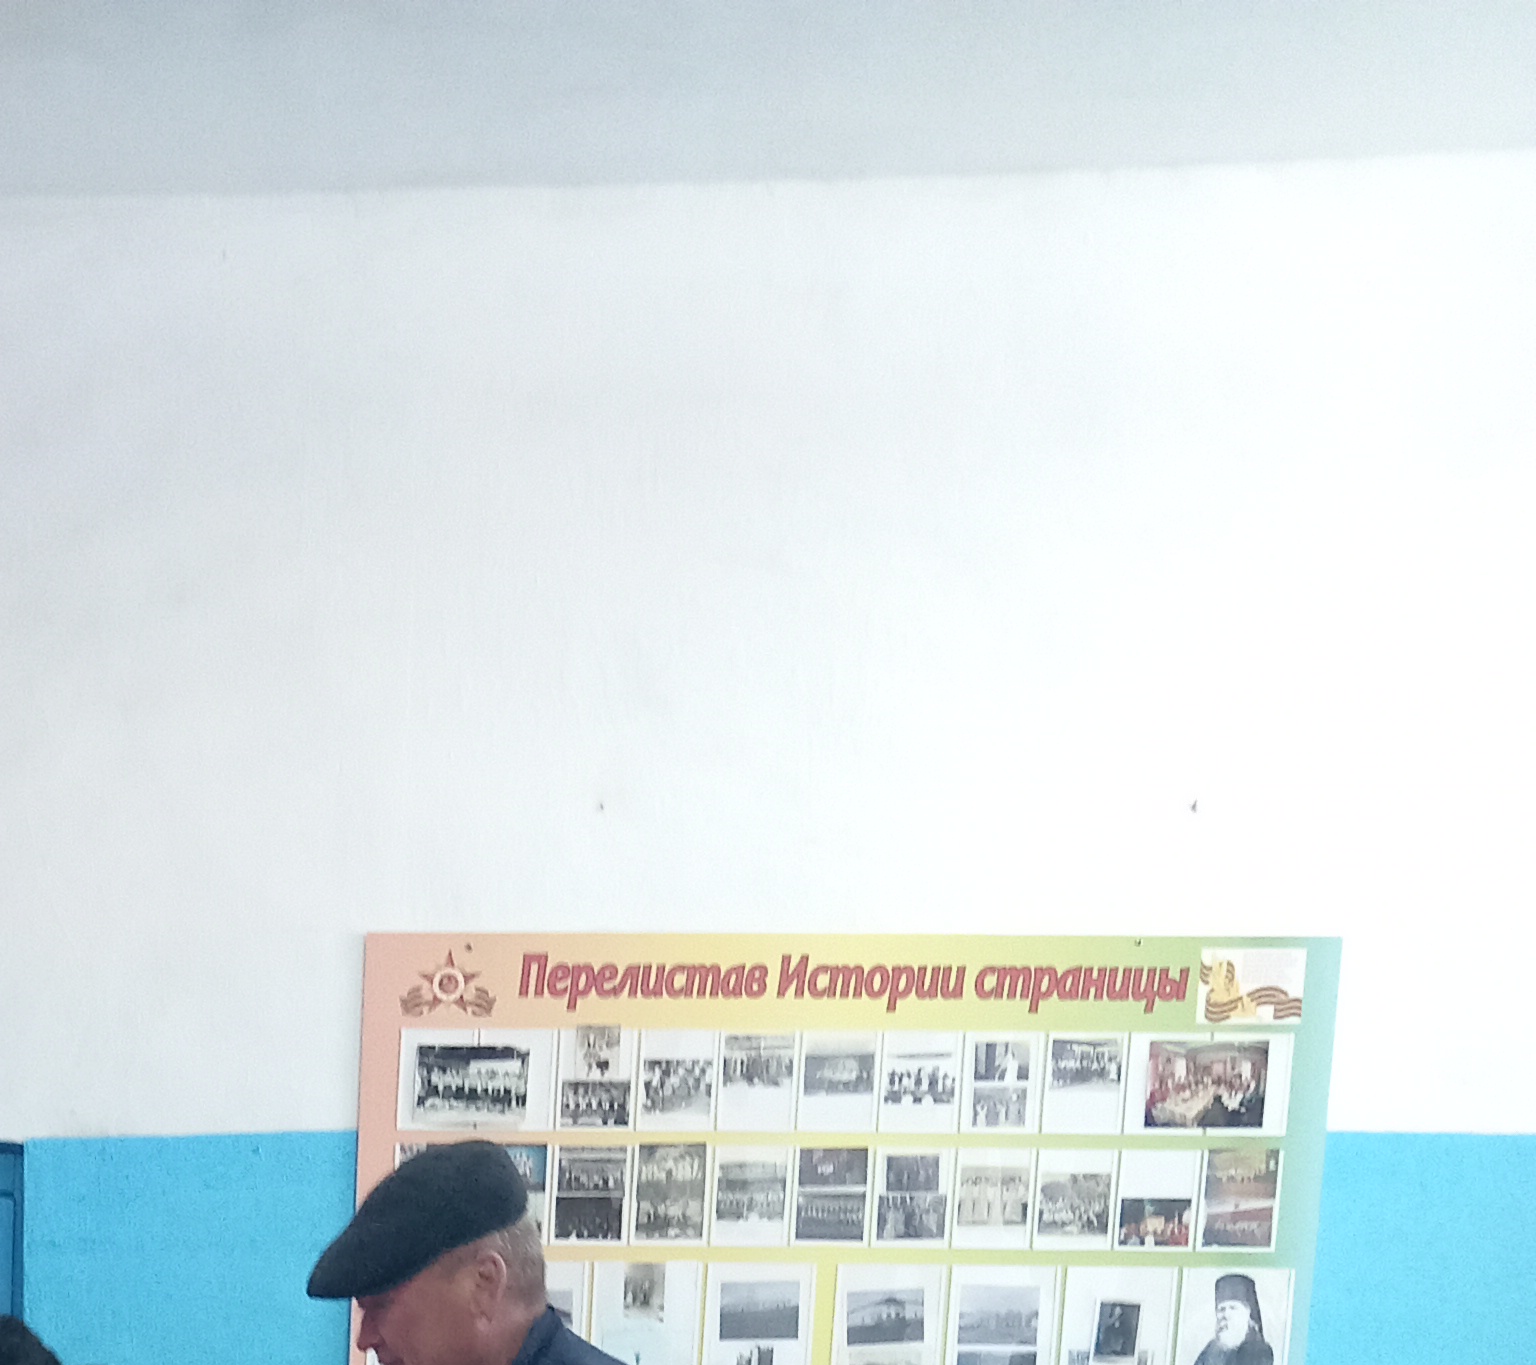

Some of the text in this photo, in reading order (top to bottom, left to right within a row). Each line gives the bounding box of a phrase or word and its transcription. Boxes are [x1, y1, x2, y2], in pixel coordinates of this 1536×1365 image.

[518, 951, 769, 1013] Перелистав
[777, 953, 966, 1013] Истории
[974, 962, 1191, 1013] страницы
